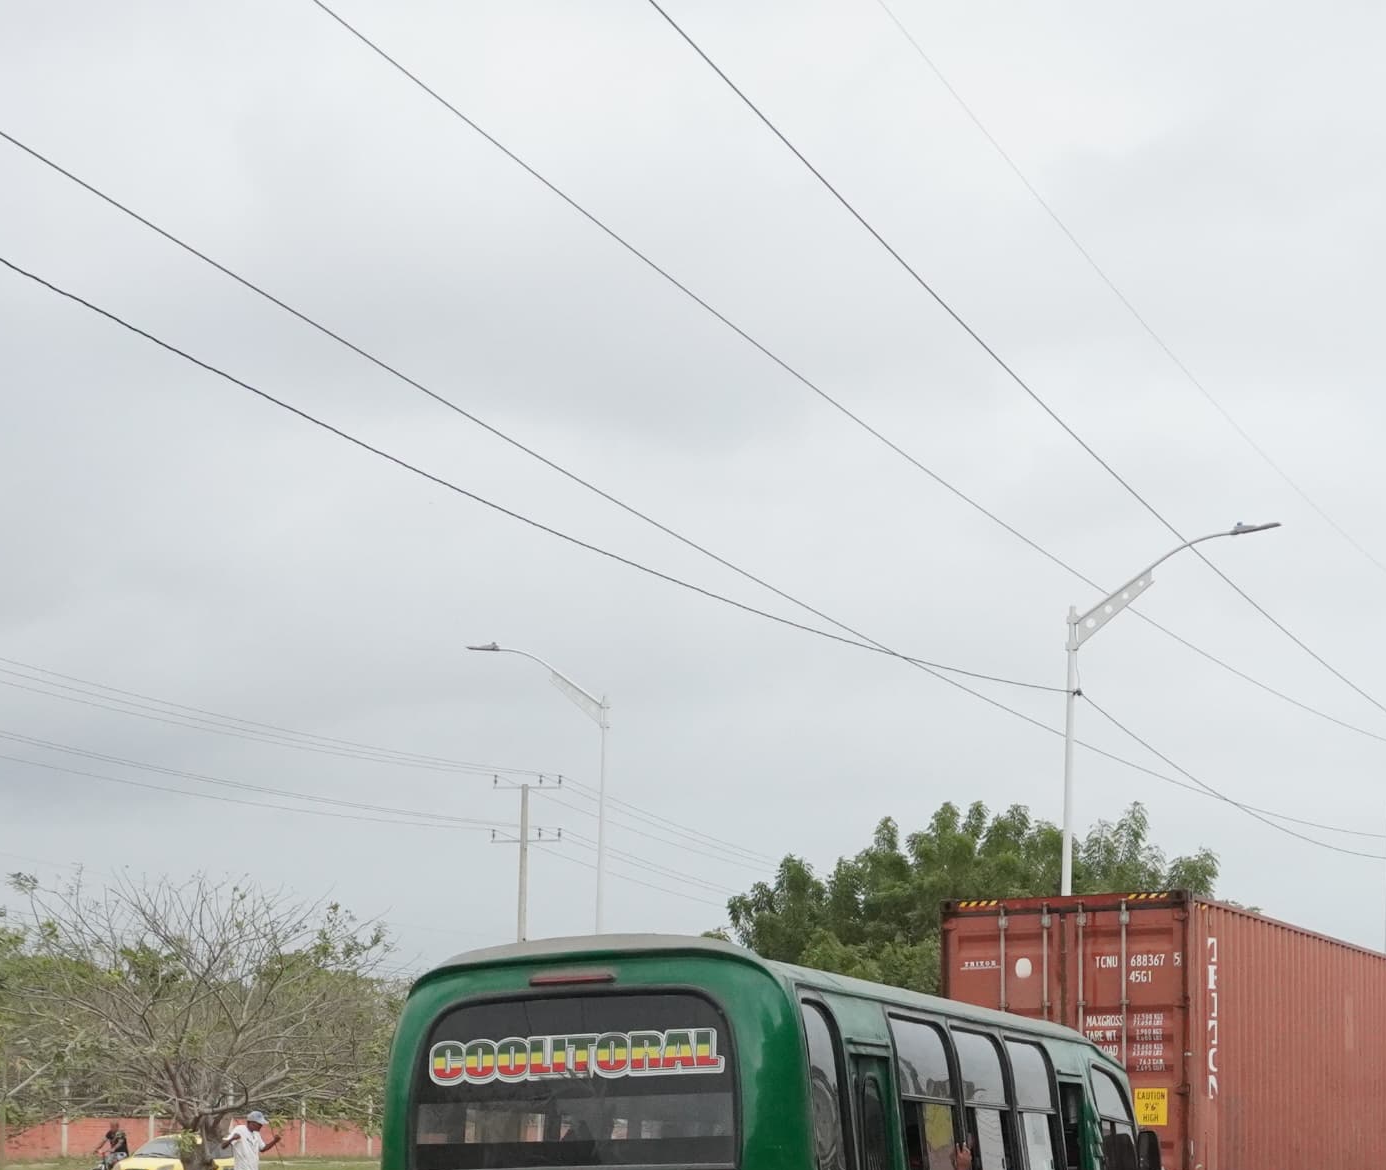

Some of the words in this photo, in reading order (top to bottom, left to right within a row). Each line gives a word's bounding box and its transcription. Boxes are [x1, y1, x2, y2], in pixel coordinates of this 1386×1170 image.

[1095, 955, 1118, 968] TCNU
[1130, 954, 1165, 967] 688367
[1174, 952, 1181, 966] 5
[1129, 970, 1152, 983] 45G1
[428, 1028, 726, 1086] COOLITORAL
[1136, 1091, 1165, 1100] CAUTION
[1142, 1113, 1159, 1122] HIGH
